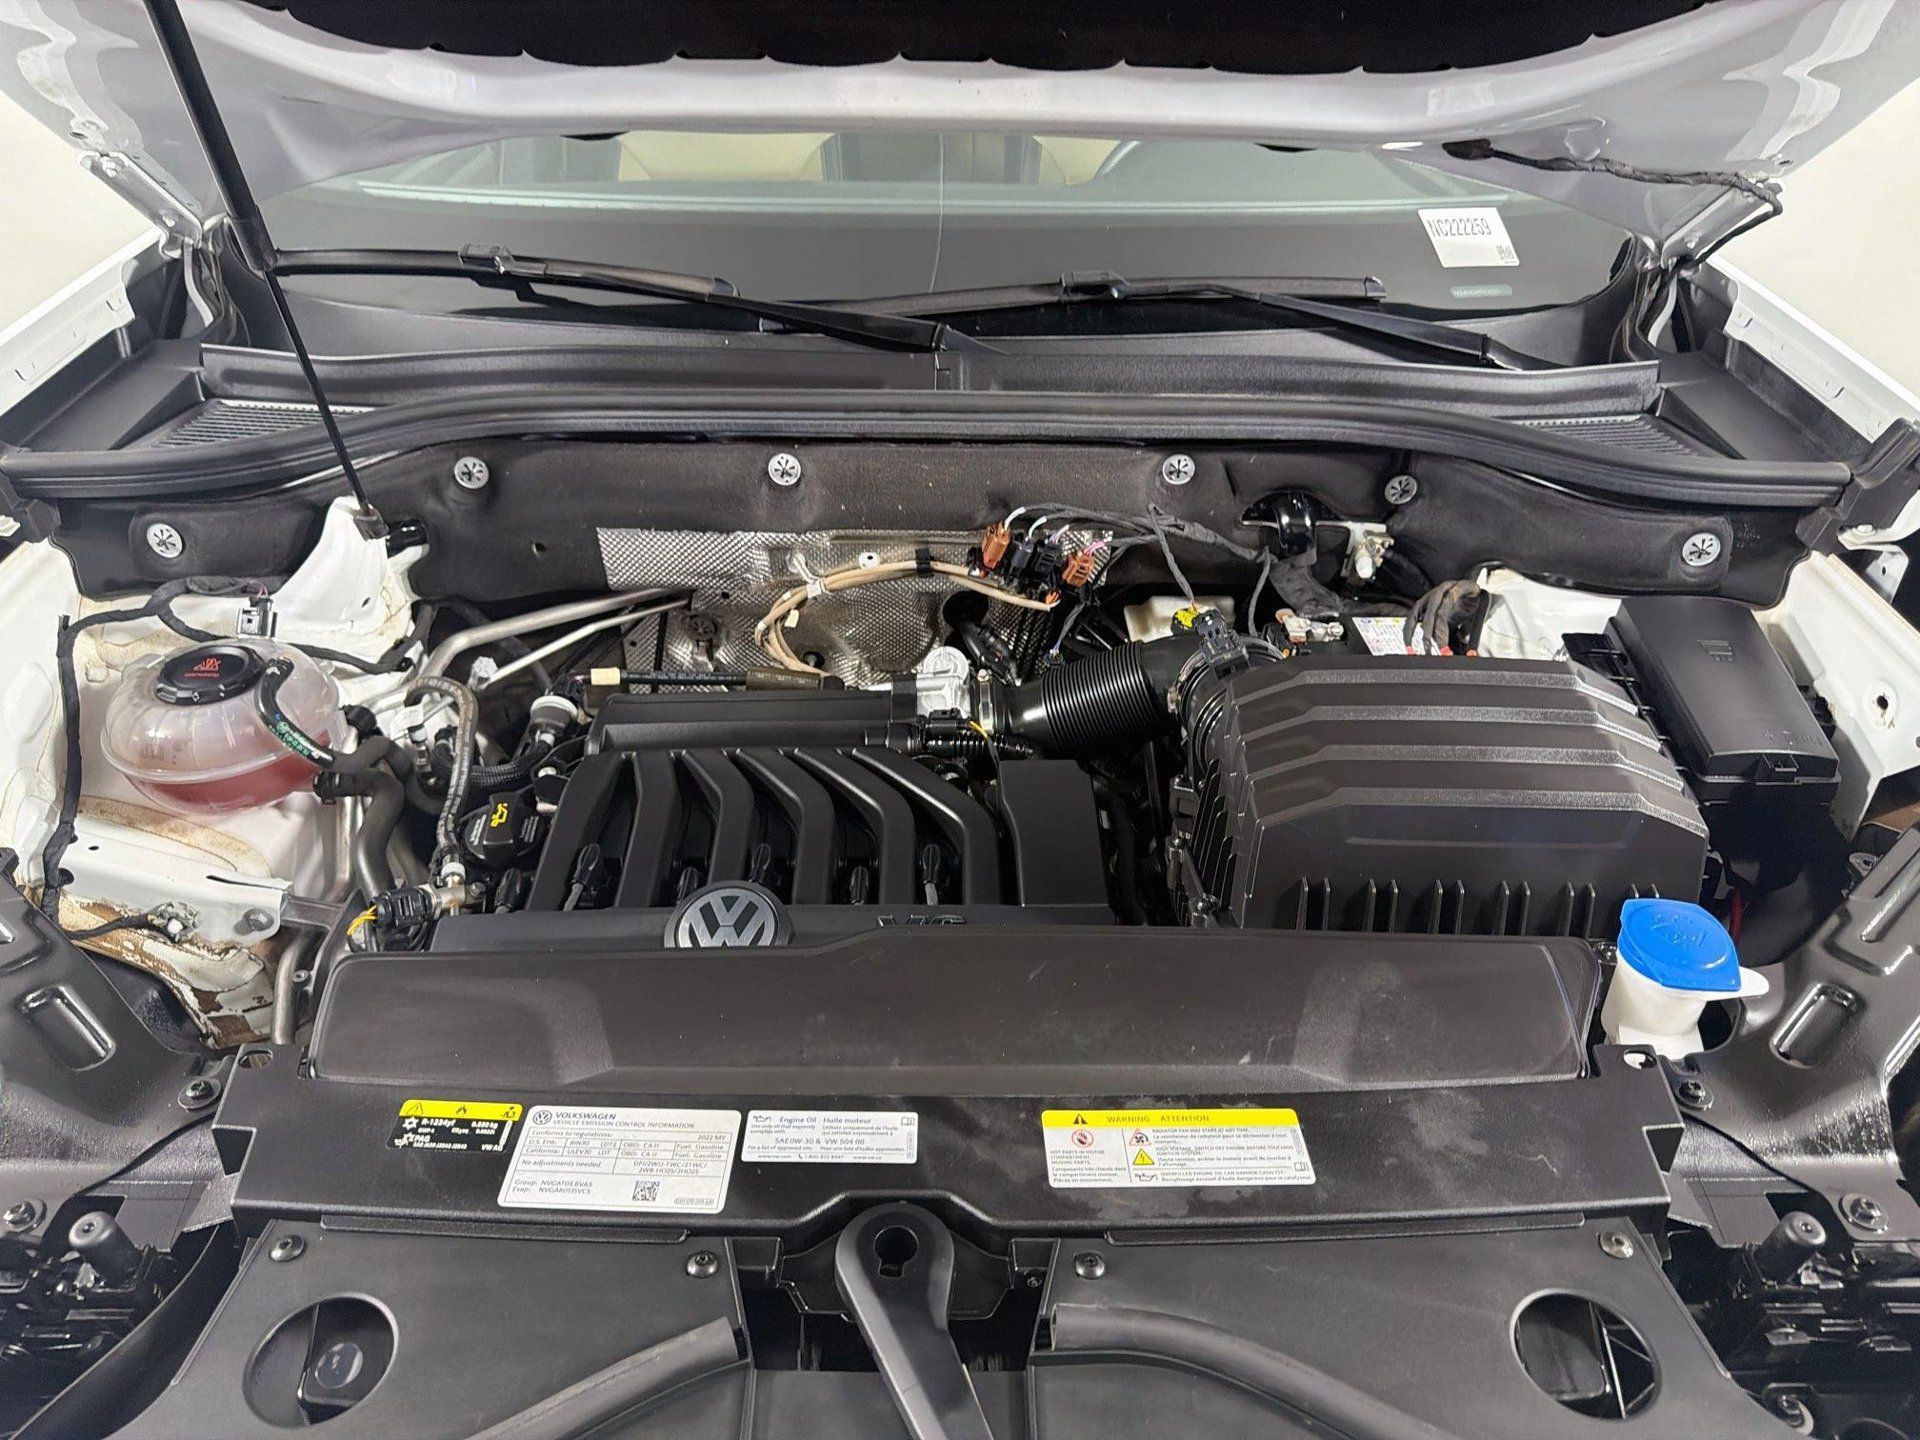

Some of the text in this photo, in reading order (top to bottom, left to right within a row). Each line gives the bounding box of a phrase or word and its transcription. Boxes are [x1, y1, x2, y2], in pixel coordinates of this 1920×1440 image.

[1427, 218, 1492, 237] NC222259
[556, 1112, 616, 1120] VOLKSWAGEN
[1106, 1115, 1150, 1123] WARNING
[421, 1118, 456, 1128] R-1234yf
